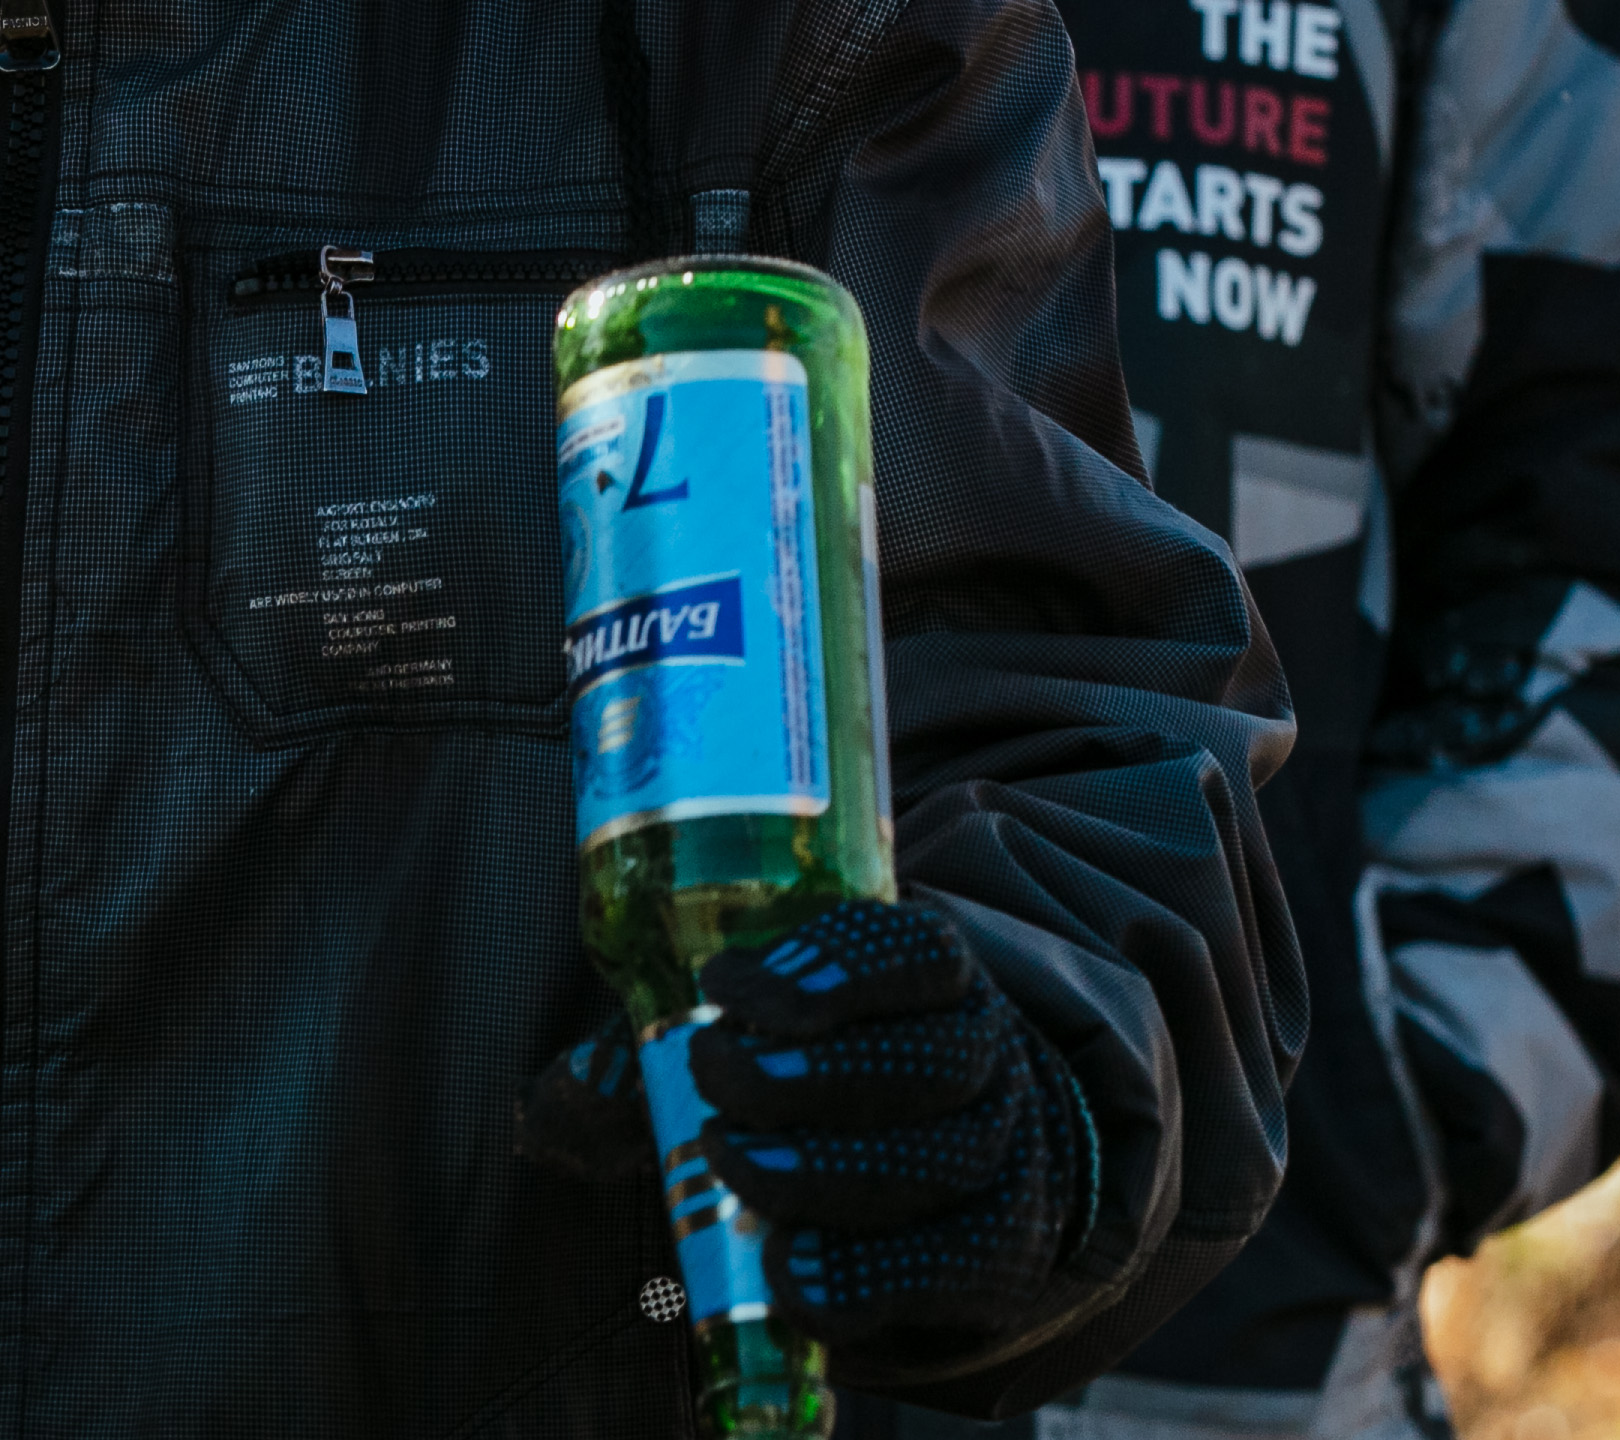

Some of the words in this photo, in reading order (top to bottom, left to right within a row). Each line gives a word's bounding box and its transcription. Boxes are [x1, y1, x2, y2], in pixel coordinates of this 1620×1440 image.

[1083, 71, 1332, 167] UTURE
[1097, 156, 1324, 257] TARTS
[1156, 248, 1317, 348] NOW
[623, 394, 689, 512] 7
